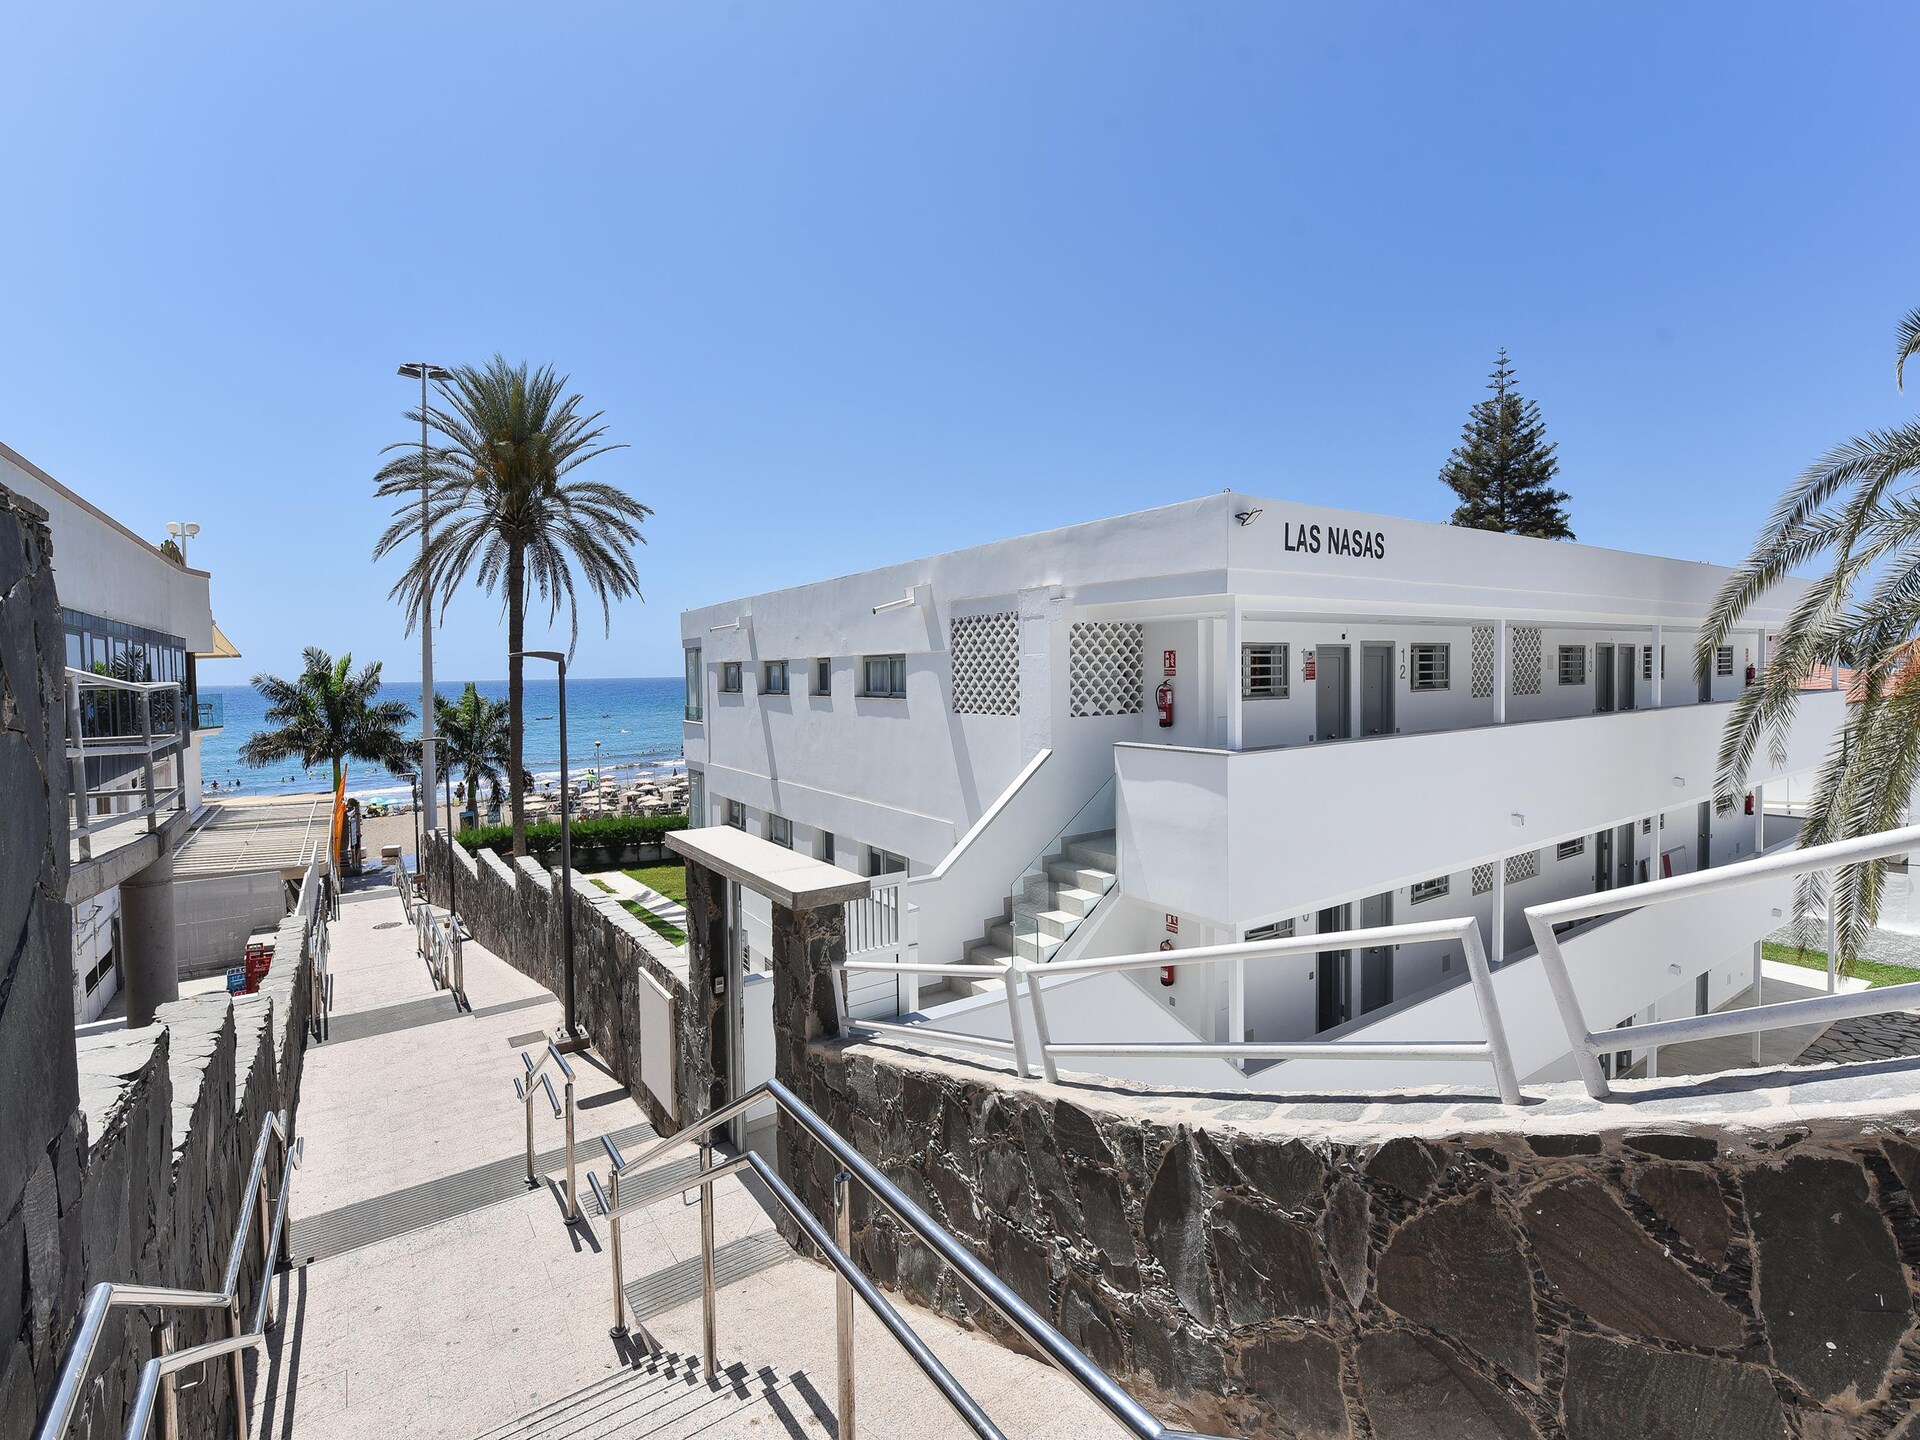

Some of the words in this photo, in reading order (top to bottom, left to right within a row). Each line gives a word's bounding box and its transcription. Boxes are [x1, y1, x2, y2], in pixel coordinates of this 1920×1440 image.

[1284, 522, 1321, 554] LAS
[1328, 527, 1385, 559] NASAS
[1400, 648, 1406, 680] 12
